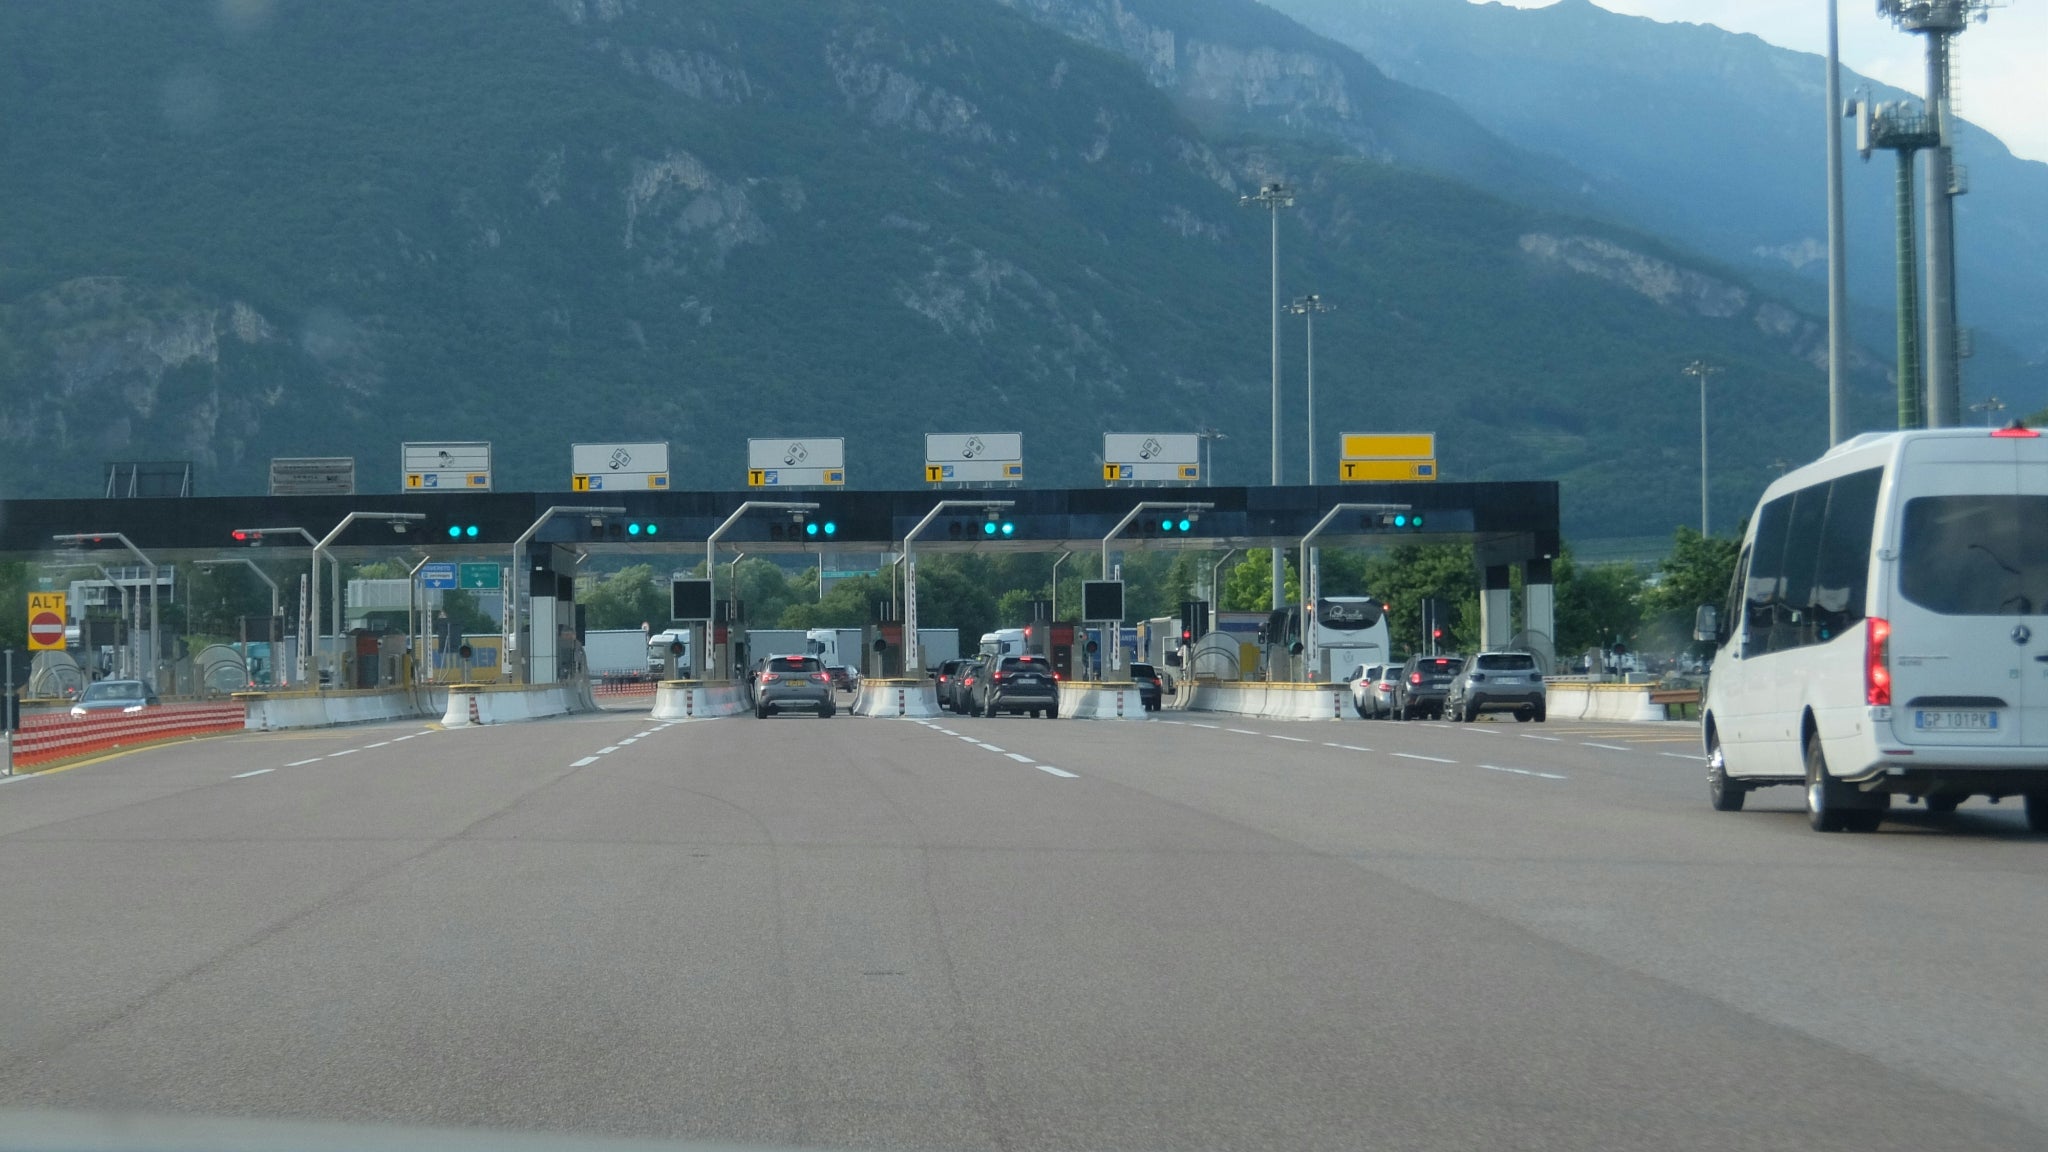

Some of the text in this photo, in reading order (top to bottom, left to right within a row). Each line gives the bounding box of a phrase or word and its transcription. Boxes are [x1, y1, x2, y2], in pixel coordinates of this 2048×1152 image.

[750, 469, 762, 482] T
[928, 469, 940, 482] T
[1106, 465, 1117, 478] T
[1344, 464, 1355, 477] T
[409, 475, 419, 486] T
[575, 476, 587, 490] T
[31, 596, 62, 609] ALT
[1924, 713, 1987, 727] GP 101PK
